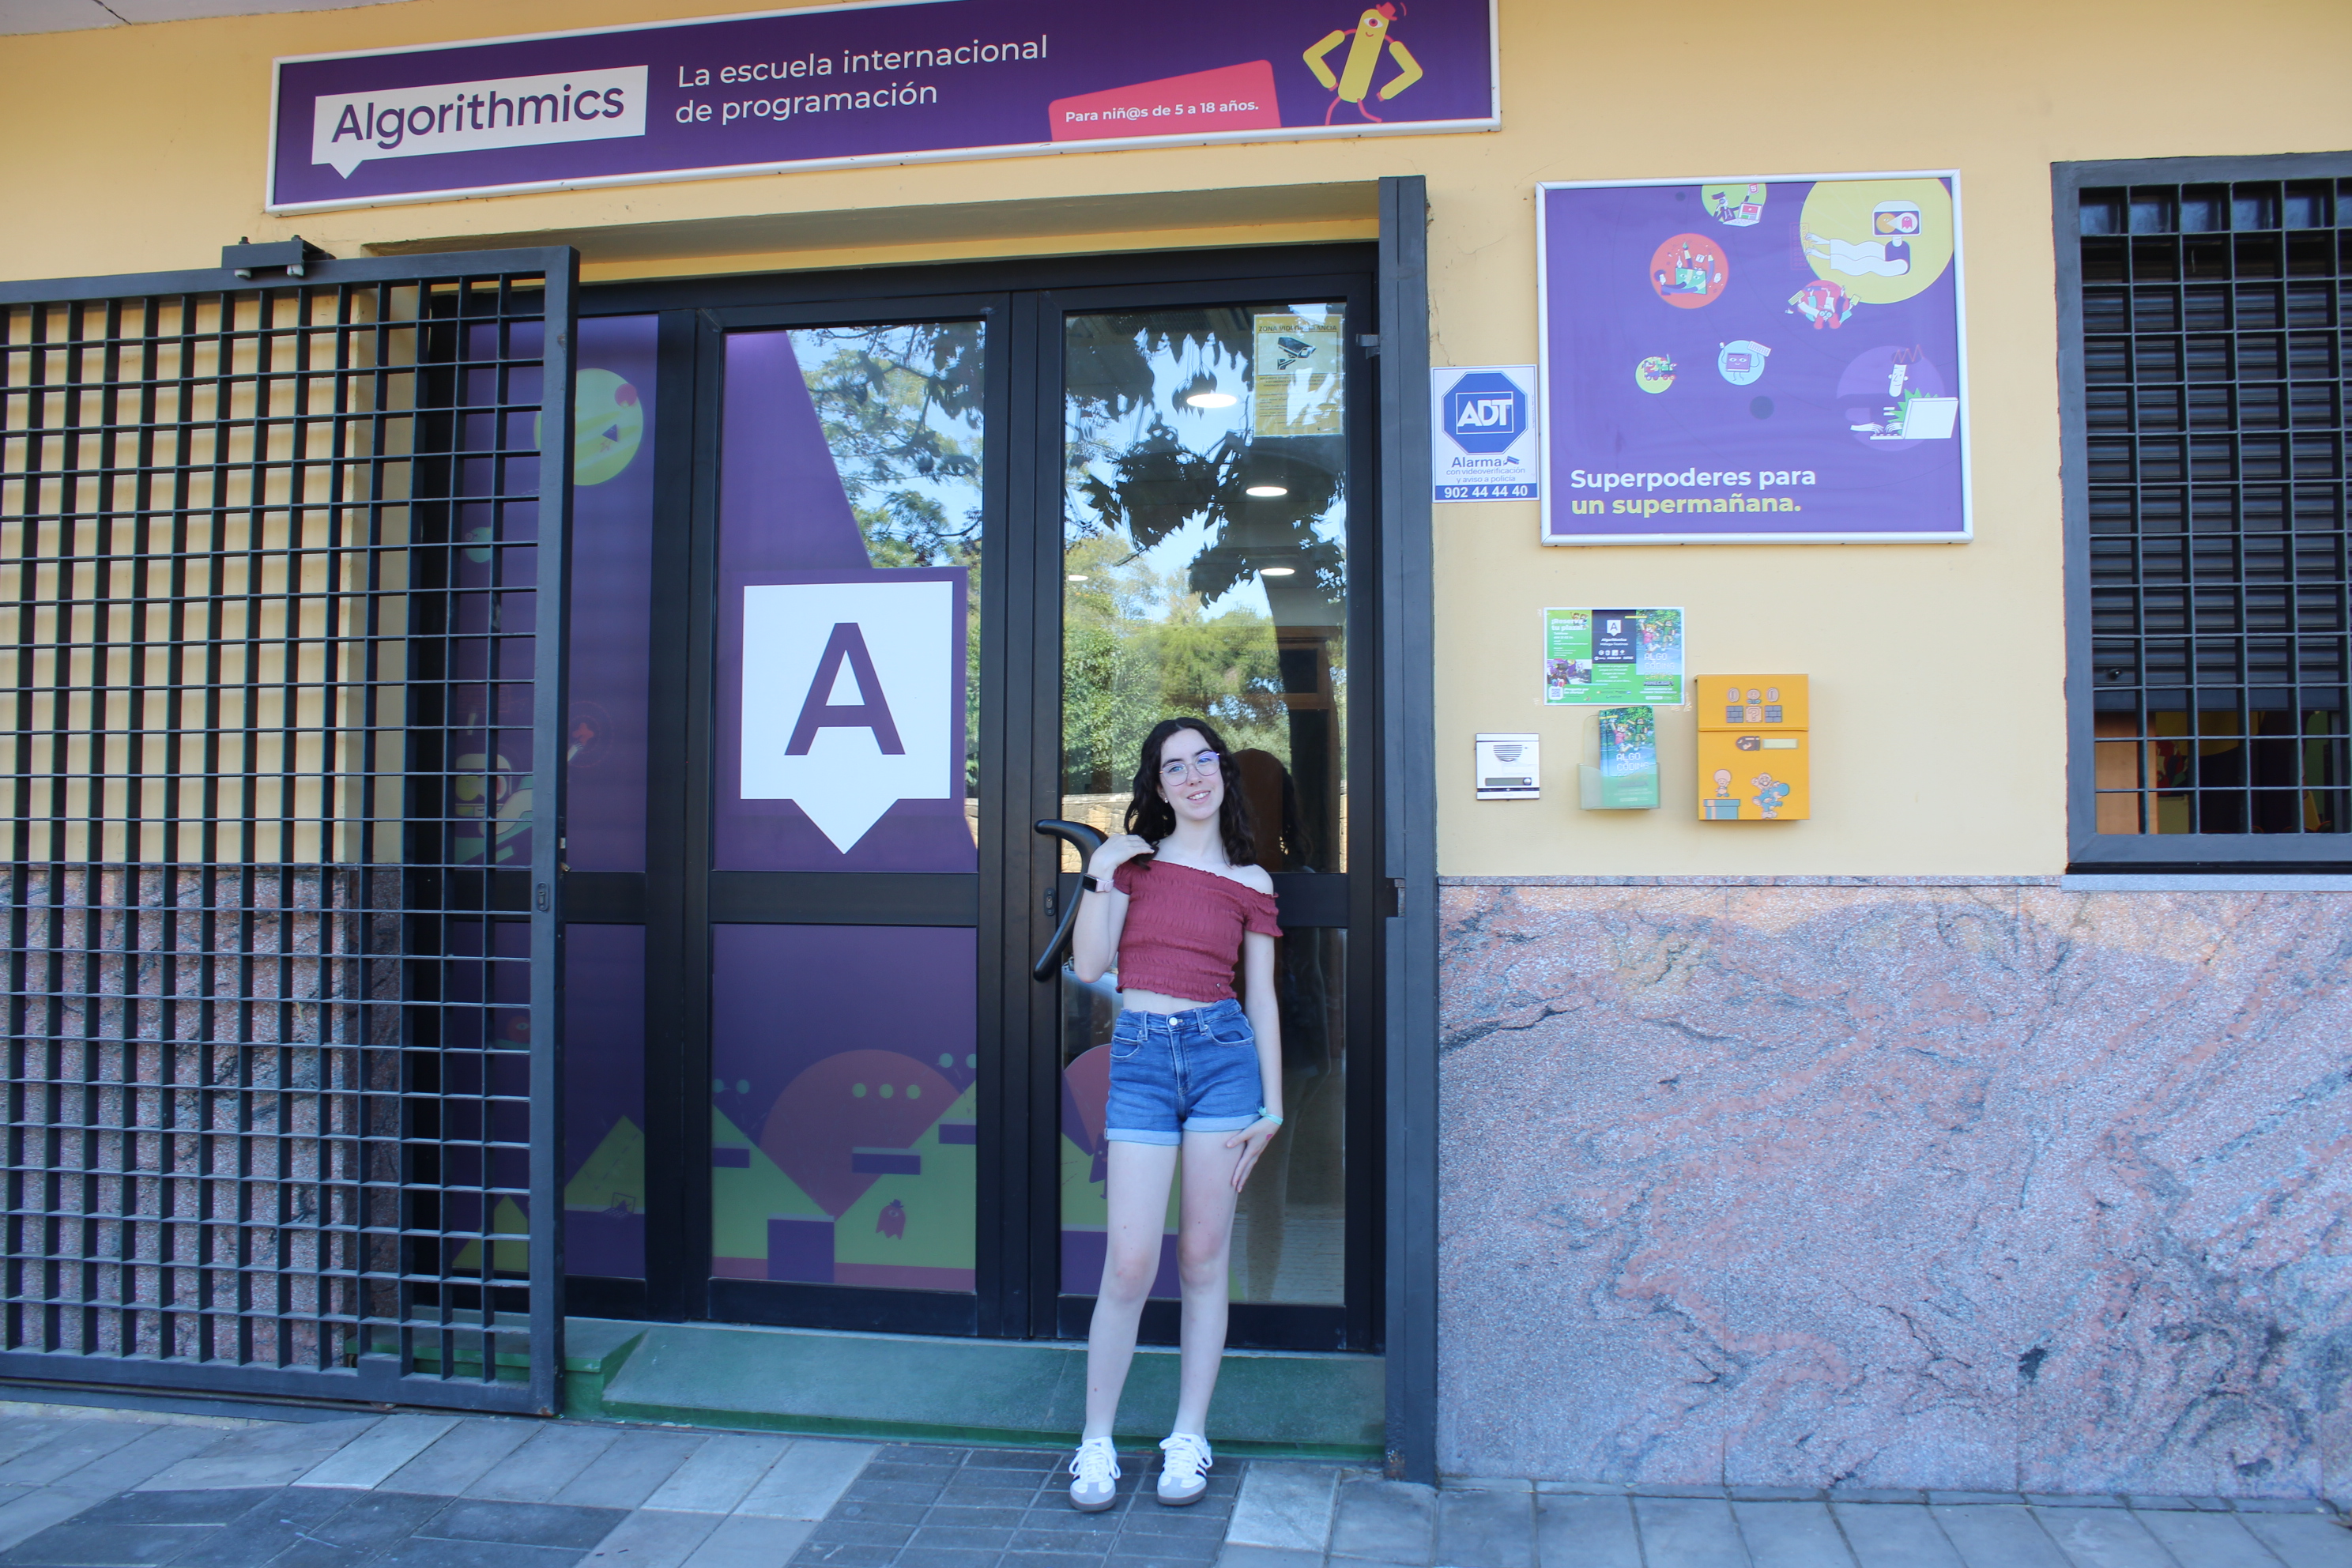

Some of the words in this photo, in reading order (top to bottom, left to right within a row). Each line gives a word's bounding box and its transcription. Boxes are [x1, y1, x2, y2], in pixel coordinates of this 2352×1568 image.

[678, 66, 710, 88] La
[719, 53, 832, 84] escuela
[843, 34, 1048, 74] internacional
[675, 100, 712, 123] de
[722, 81, 937, 126] programación
[1065, 111, 1099, 122] Para
[1102, 107, 1148, 121] niñ@s
[1152, 105, 1171, 117] de
[1174, 104, 1184, 115] 5
[1187, 104, 1196, 114] a
[1200, 102, 1215, 113] 18
[1219, 100, 1259, 111] años.
[330, 84, 624, 150] Algorithmics
[1457, 399, 1513, 427] ADT
[1451, 457, 1502, 468] Alarma
[1444, 486, 1468, 499] 902
[1472, 486, 1489, 497] 44
[1491, 485, 1509, 497] 44
[1511, 484, 1528, 496] 40
[1491, 475, 1516, 484] policía
[1570, 467, 1751, 492] Superpoderes
[1758, 469, 1816, 490] para
[1571, 499, 1604, 514] un
[1611, 492, 1802, 518] supermañana.
[784, 622, 906, 756] A
[1616, 752, 1641, 761] ALGO
